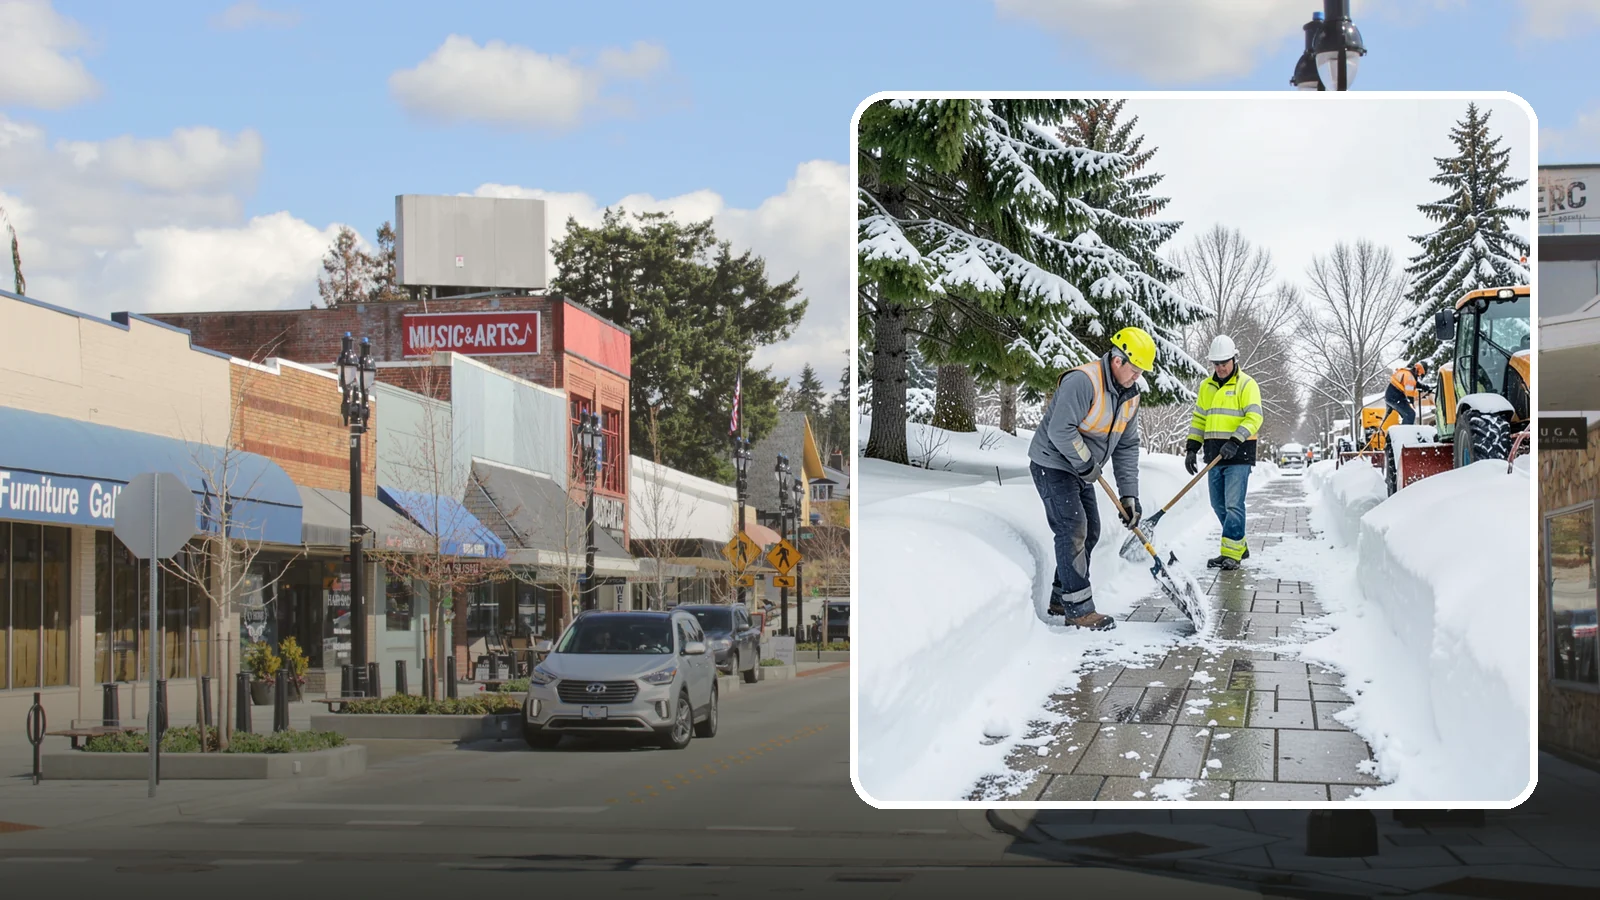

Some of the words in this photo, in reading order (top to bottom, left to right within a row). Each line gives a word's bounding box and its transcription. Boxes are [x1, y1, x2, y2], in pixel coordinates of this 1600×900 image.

[409, 323, 519, 349] MUSIC&ARTS
[1540, 427, 1577, 436] UGA
[0, 471, 79, 515] Furniture
[453, 563, 479, 574] SUSHI
